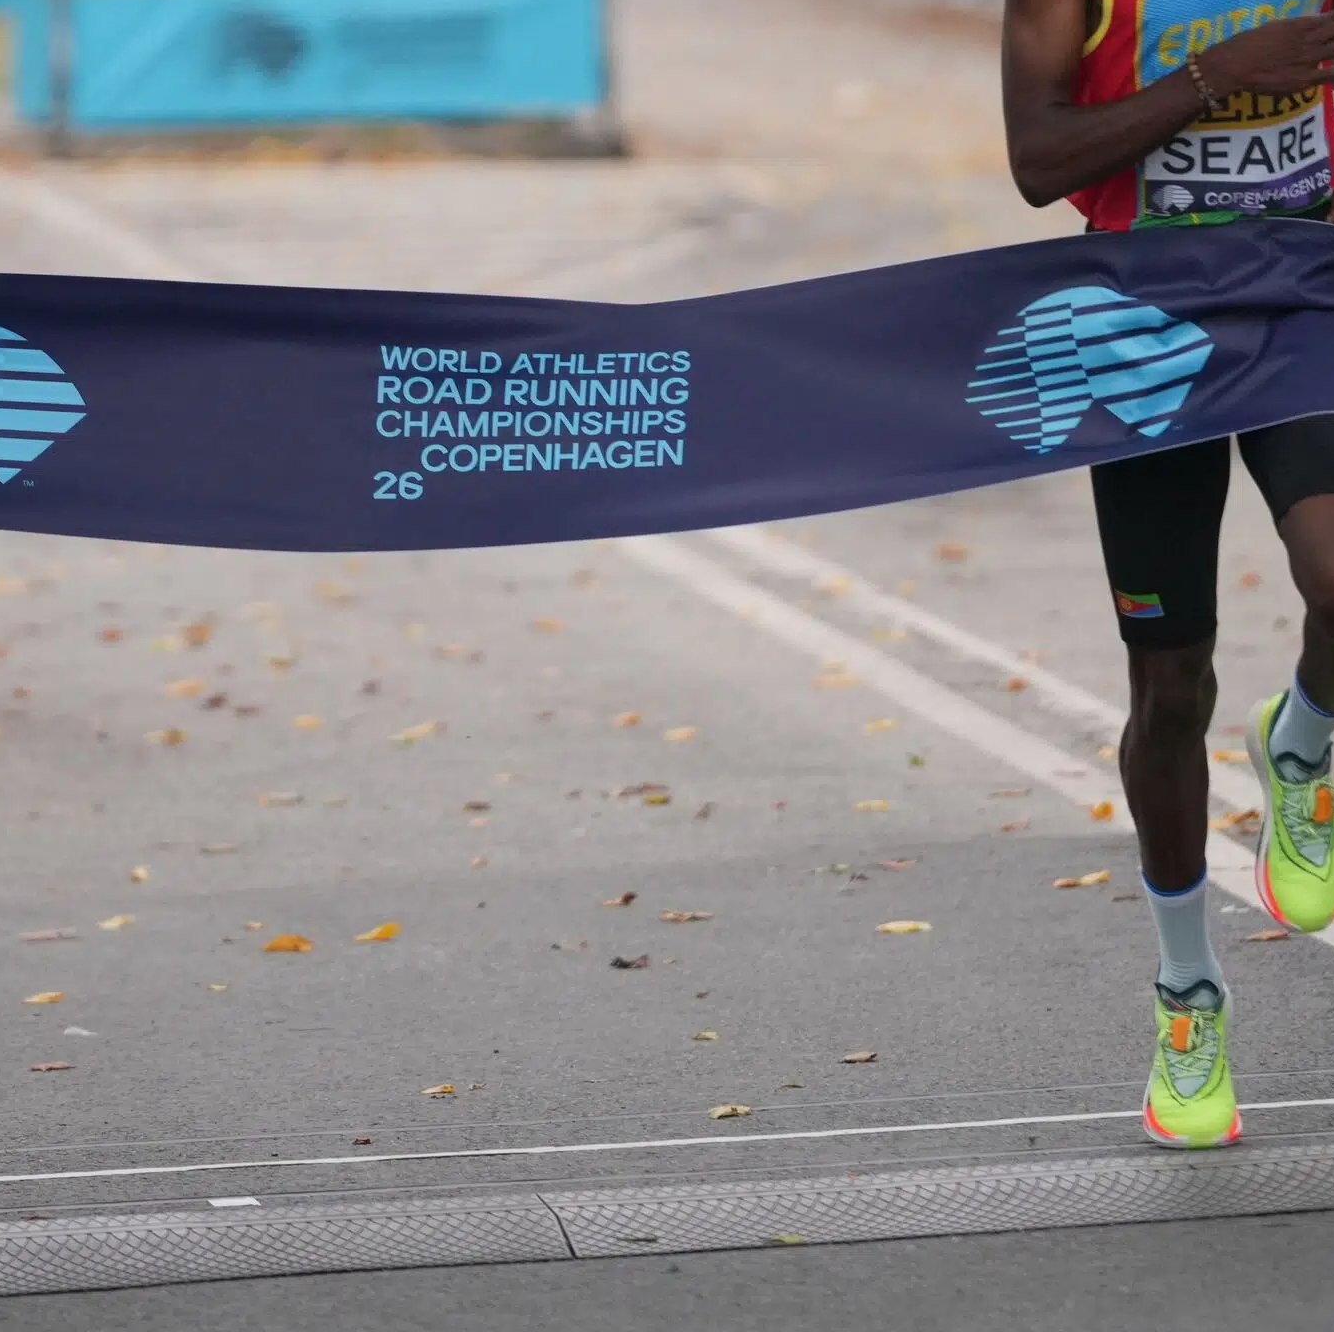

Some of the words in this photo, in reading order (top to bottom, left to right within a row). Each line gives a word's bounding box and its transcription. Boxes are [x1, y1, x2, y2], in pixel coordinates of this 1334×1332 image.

[1161, 116, 1317, 176] SEARE
[1204, 179, 1316, 207] COPENHAGEN
[380, 345, 502, 374] WORLD
[510, 350, 691, 374] ATHLETICS
[377, 375, 492, 405] ROAD
[504, 377, 689, 406] RUNNING
[376, 409, 687, 438] CHAMPIONSHIPS
[420, 440, 684, 472] COPENHAGEN
[373, 471, 424, 500] 26
